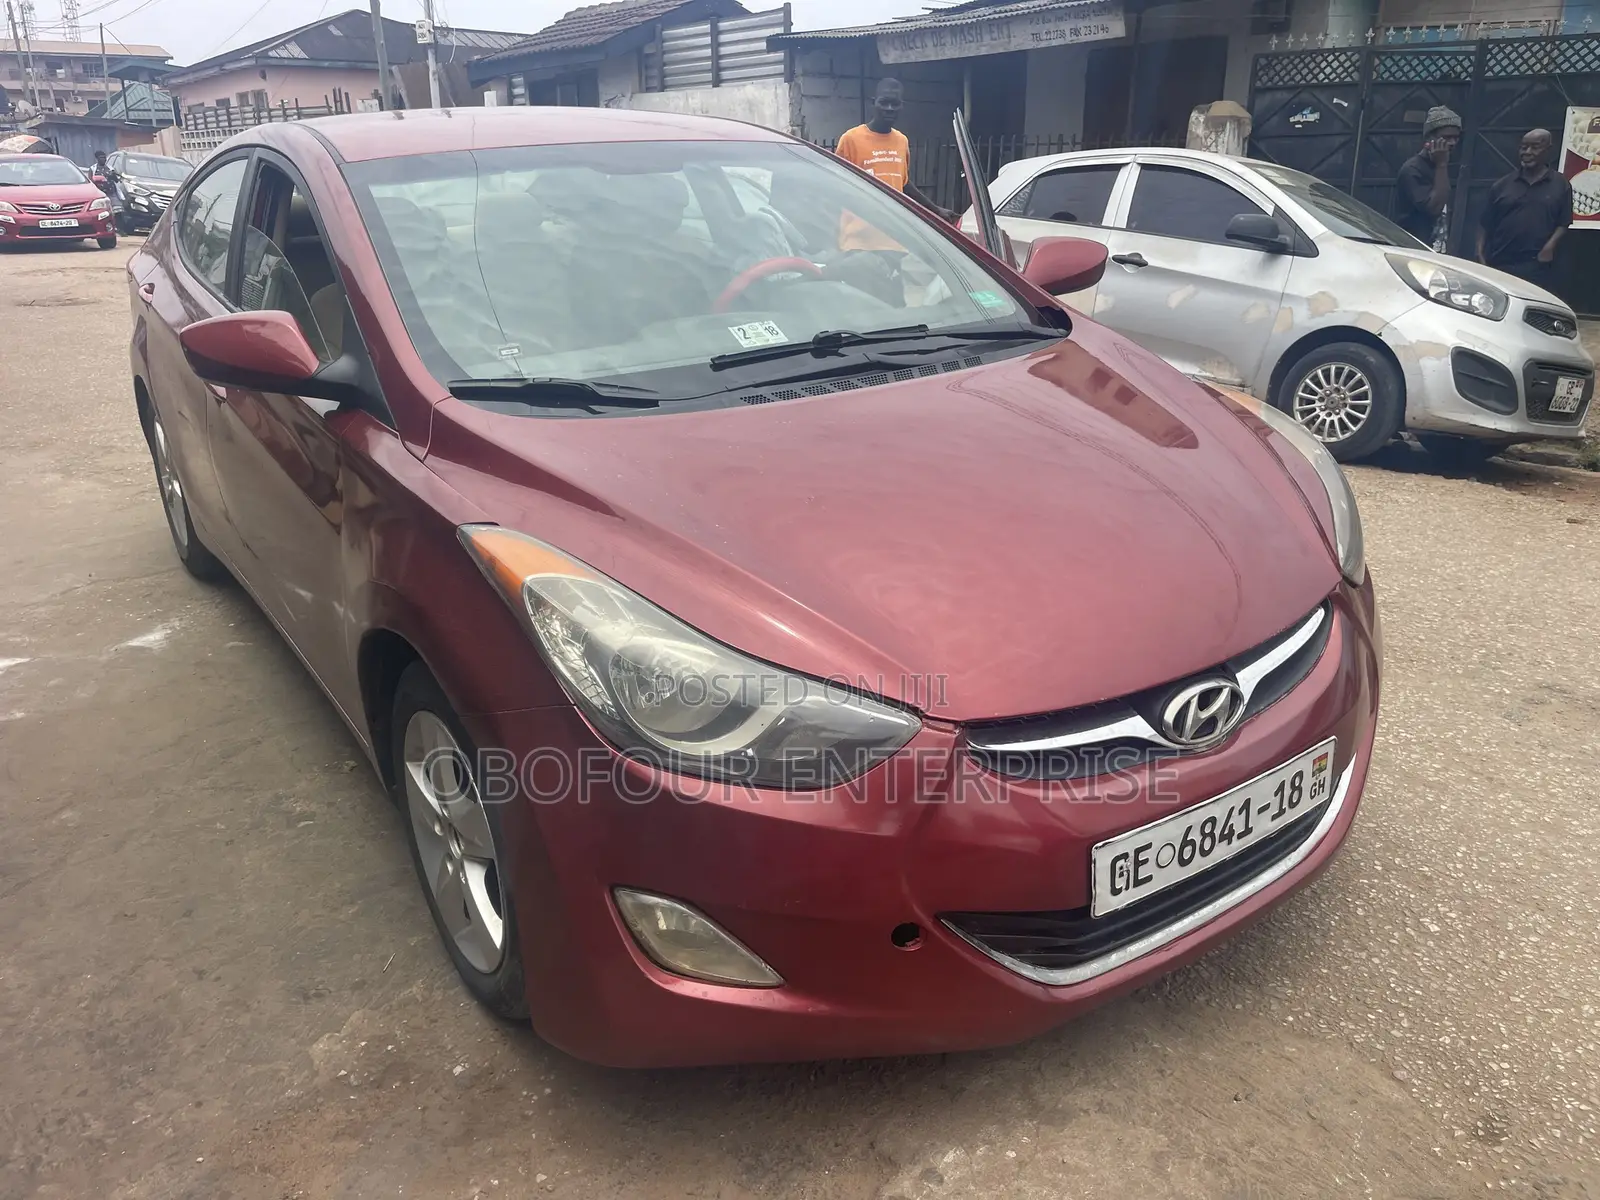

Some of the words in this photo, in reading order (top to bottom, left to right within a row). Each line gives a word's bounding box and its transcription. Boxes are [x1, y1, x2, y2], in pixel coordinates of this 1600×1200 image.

[737, 327, 752, 340] 2
[764, 325, 779, 337] 18
[1109, 841, 1154, 897] GE
[1177, 769, 1305, 868] 6841-18
[1309, 776, 1326, 800] GH
